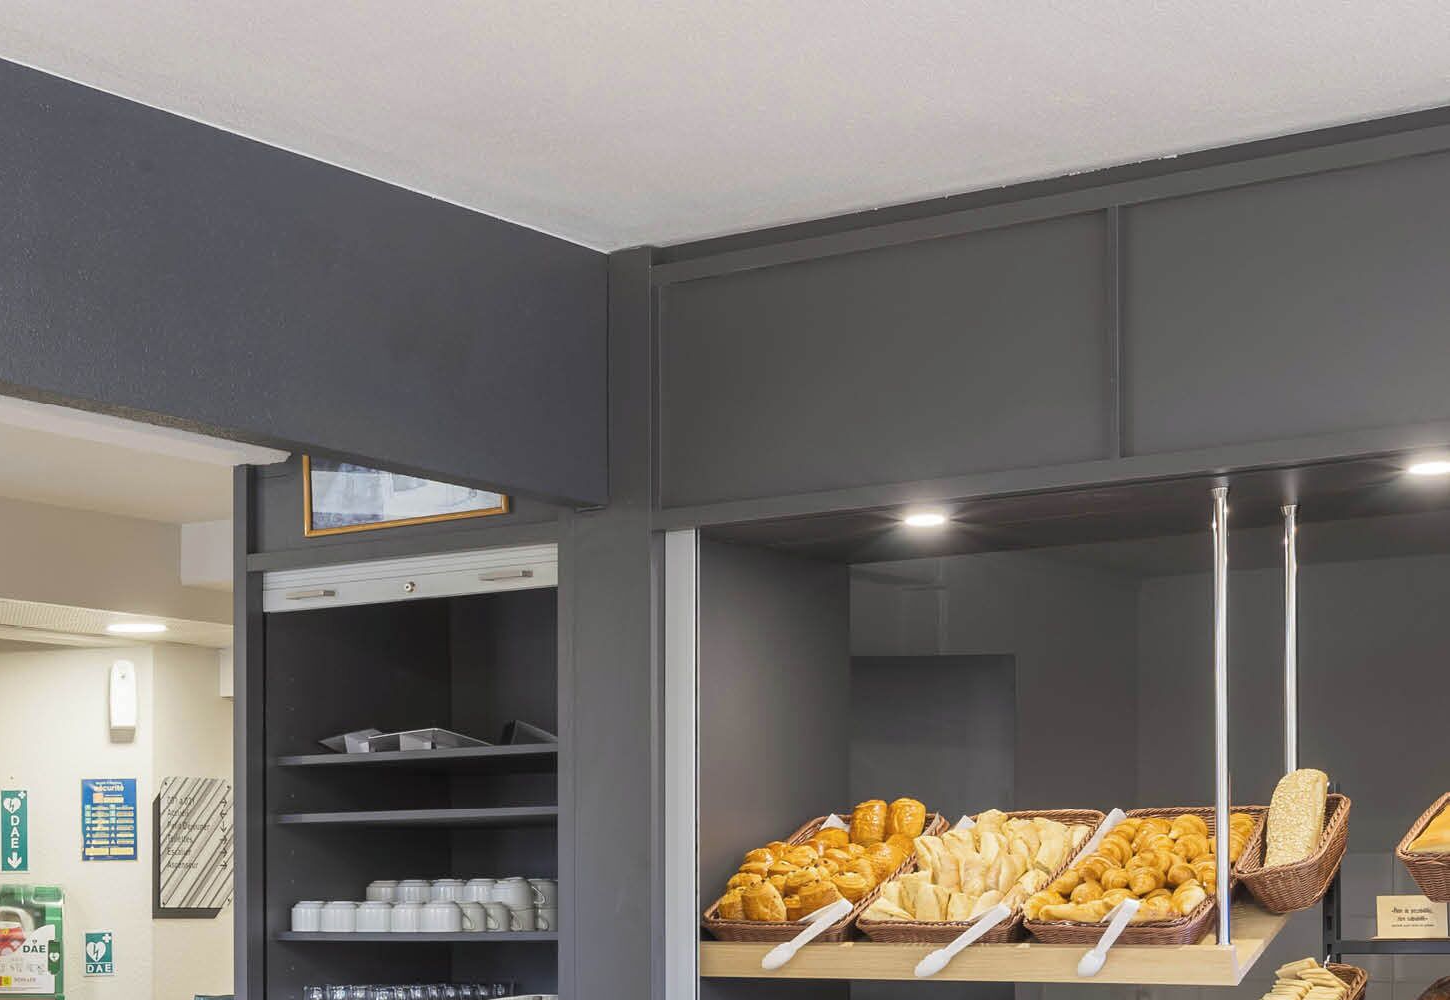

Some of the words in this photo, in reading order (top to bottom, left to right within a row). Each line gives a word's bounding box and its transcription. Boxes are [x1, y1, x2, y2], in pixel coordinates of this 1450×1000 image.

[10, 815, 20, 849] DAE
[22, 944, 46, 953] DAE
[87, 964, 111, 973] DAE
